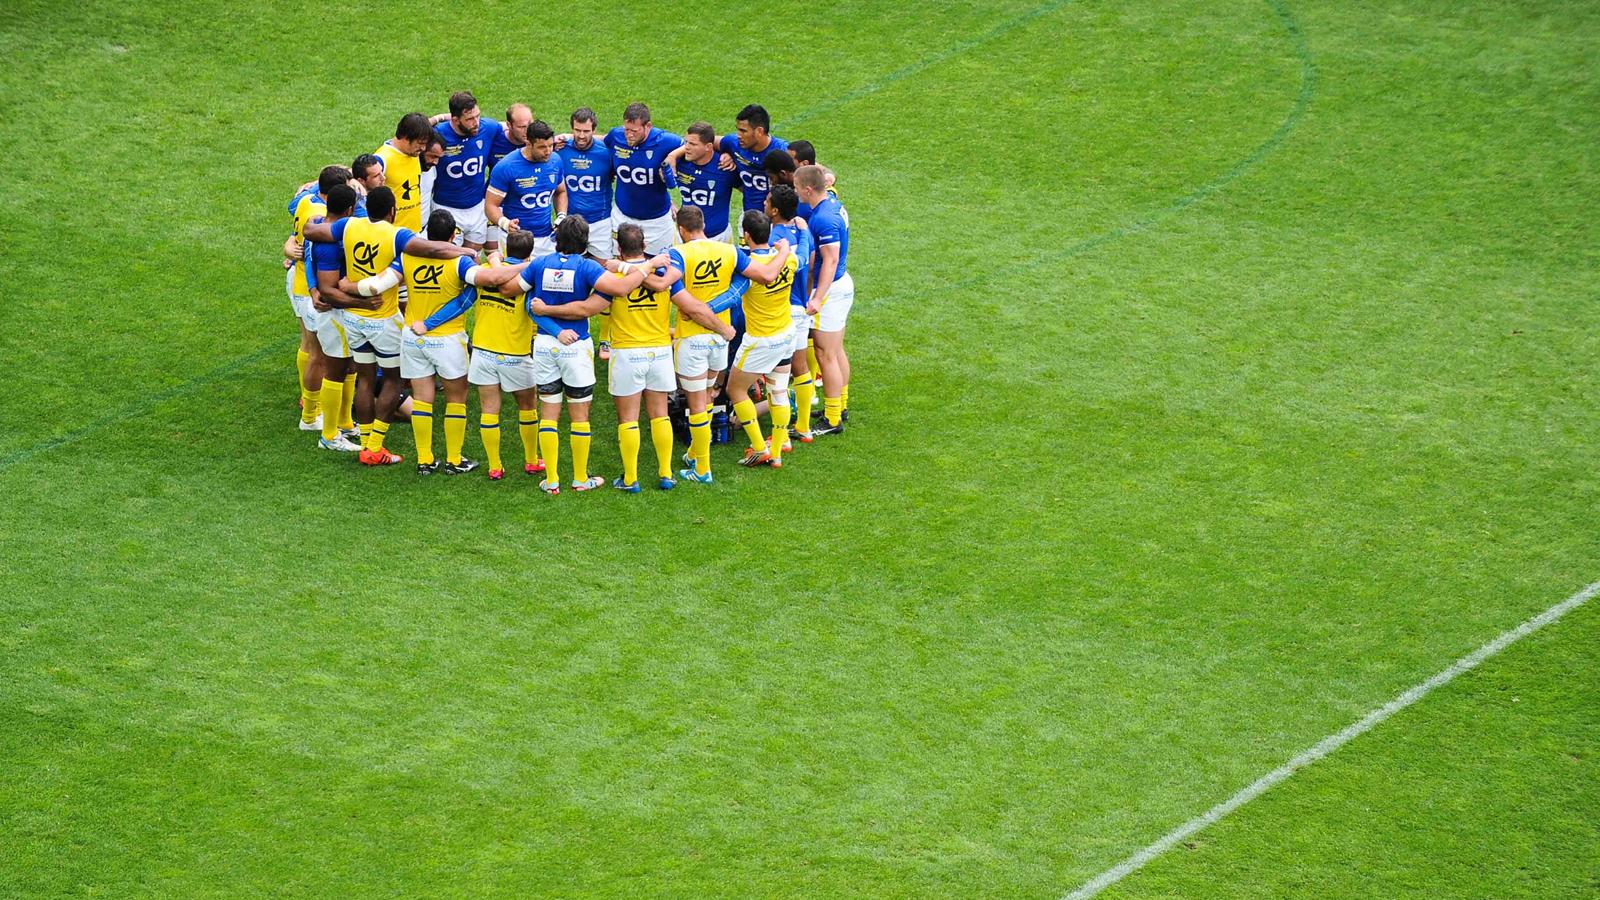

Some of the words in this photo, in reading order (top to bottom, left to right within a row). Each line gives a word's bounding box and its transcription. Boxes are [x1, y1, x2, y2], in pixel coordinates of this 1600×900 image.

[446, 156, 484, 179] CGI
[616, 165, 654, 185] CGI
[565, 174, 601, 193] CGI
[680, 186, 716, 207] CGI
